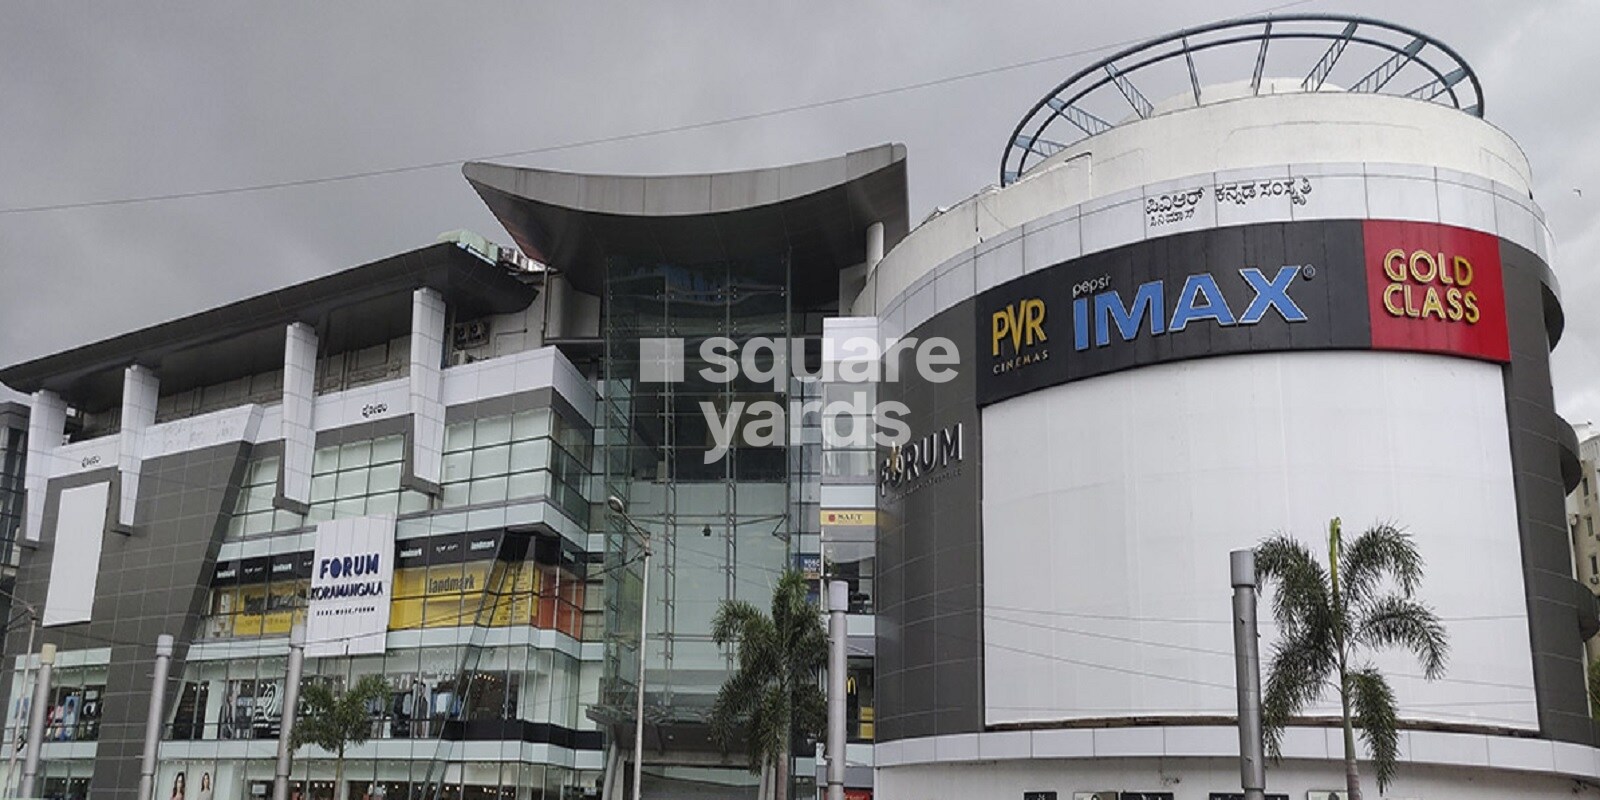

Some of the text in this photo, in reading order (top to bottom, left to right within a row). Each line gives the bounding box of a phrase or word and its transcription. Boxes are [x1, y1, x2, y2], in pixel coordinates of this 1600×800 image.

[1215, 181, 1256, 205] ಕನ್ನಡ
[1260, 176, 1313, 206] ಸಂಸ್ಕೃತಿ
[1384, 248, 1474, 286] GOLD
[1383, 282, 1480, 324] CLASS
[992, 298, 1047, 356] PVR
[993, 349, 1049, 374] CINEMAS
[880, 421, 963, 497] FORUM
[319, 553, 379, 579] FORUM
[311, 580, 383, 601] KORAMANGALA
[428, 574, 475, 594] landmark
